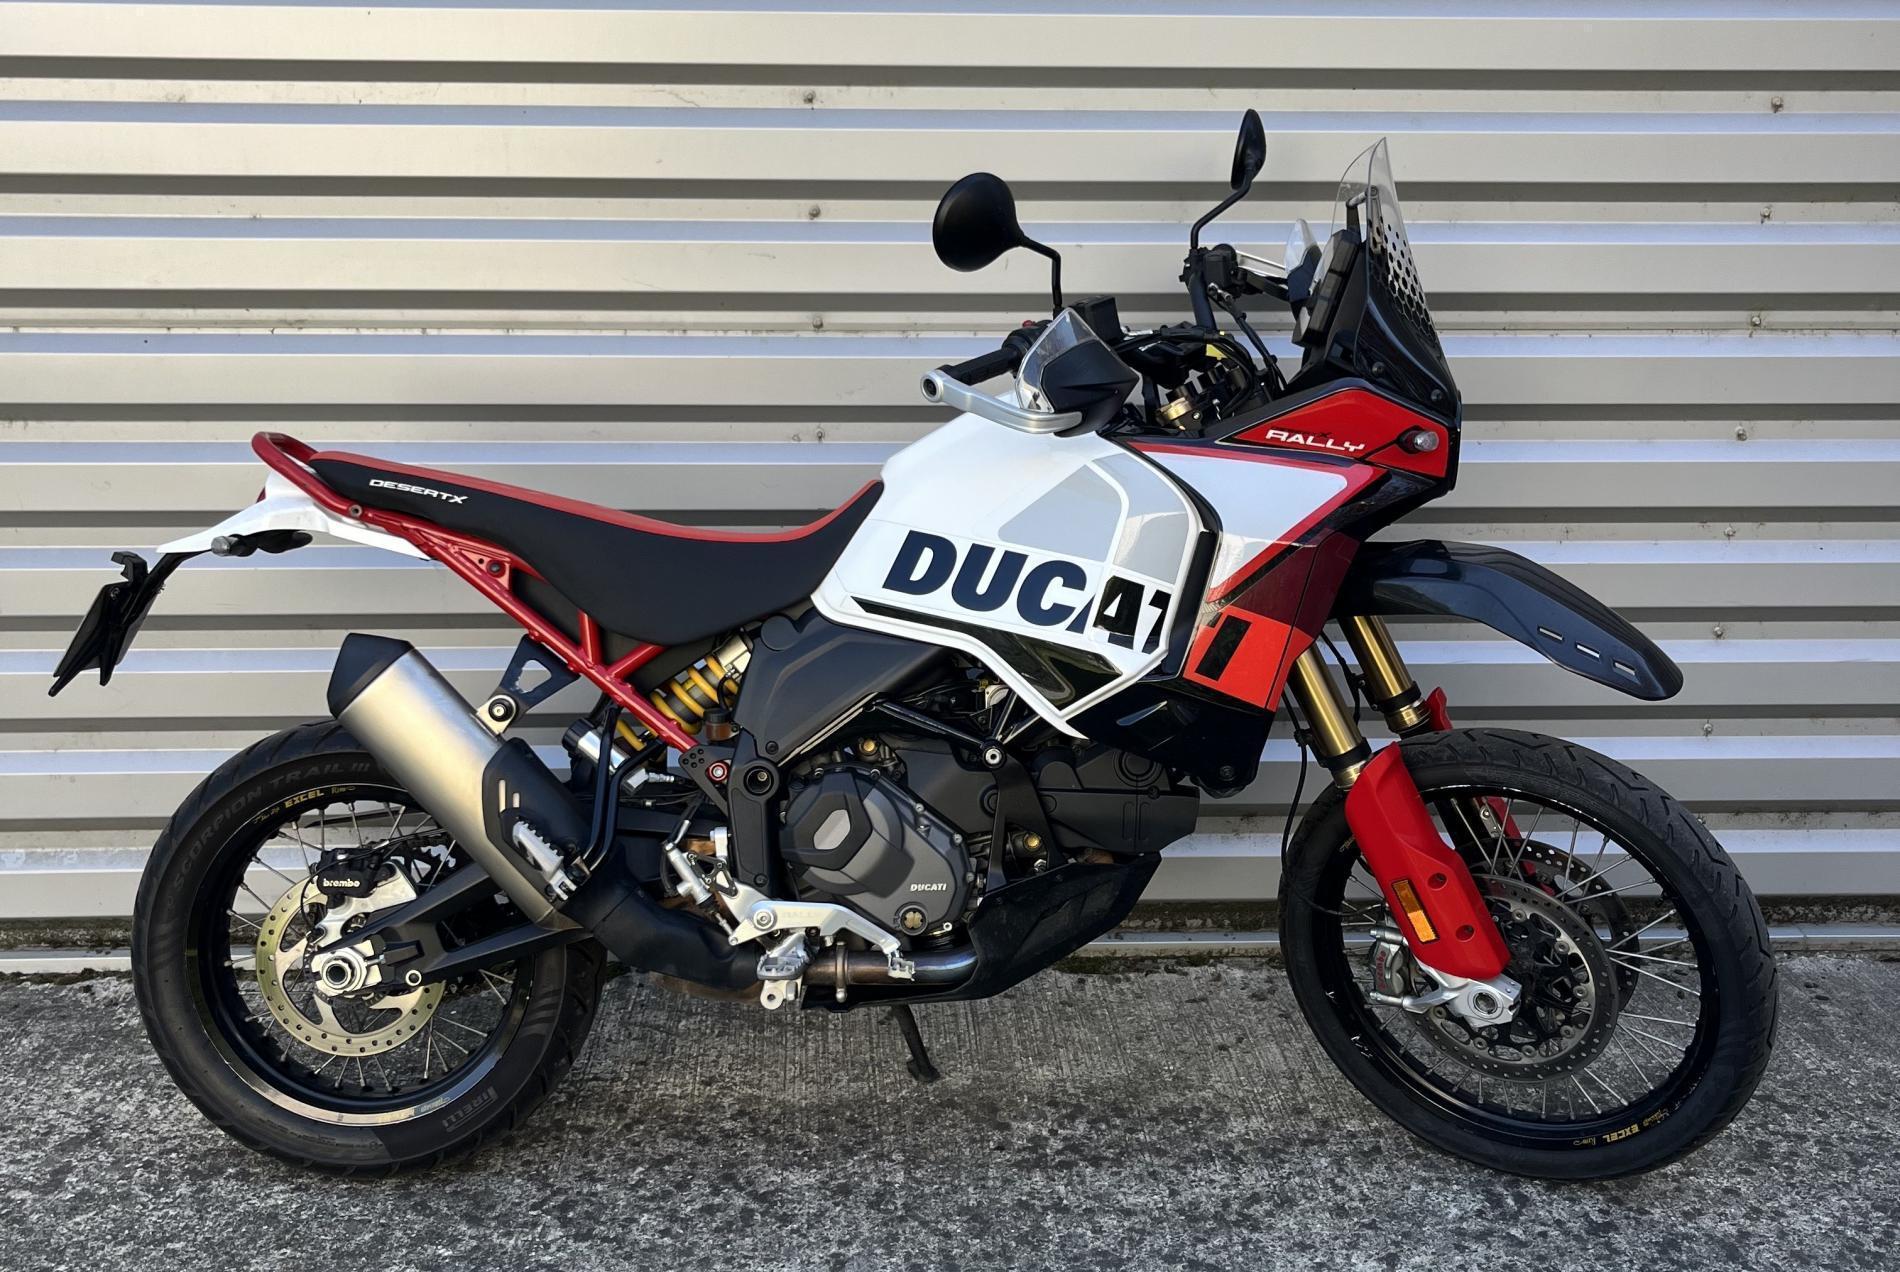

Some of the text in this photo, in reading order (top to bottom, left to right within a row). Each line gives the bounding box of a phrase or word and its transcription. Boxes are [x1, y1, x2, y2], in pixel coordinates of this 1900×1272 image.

[1265, 429, 1365, 451] RALLY
[369, 479, 469, 504] DESERTX
[284, 789, 325, 808] EXCEL
[174, 786, 263, 887] SCORPION
[270, 761, 344, 788] TRAIL
[323, 878, 360, 888] brembo
[910, 883, 947, 891] DUCATI
[442, 1087, 497, 1132] PIRELLI
[1602, 1123, 1640, 1142] EXCEL
